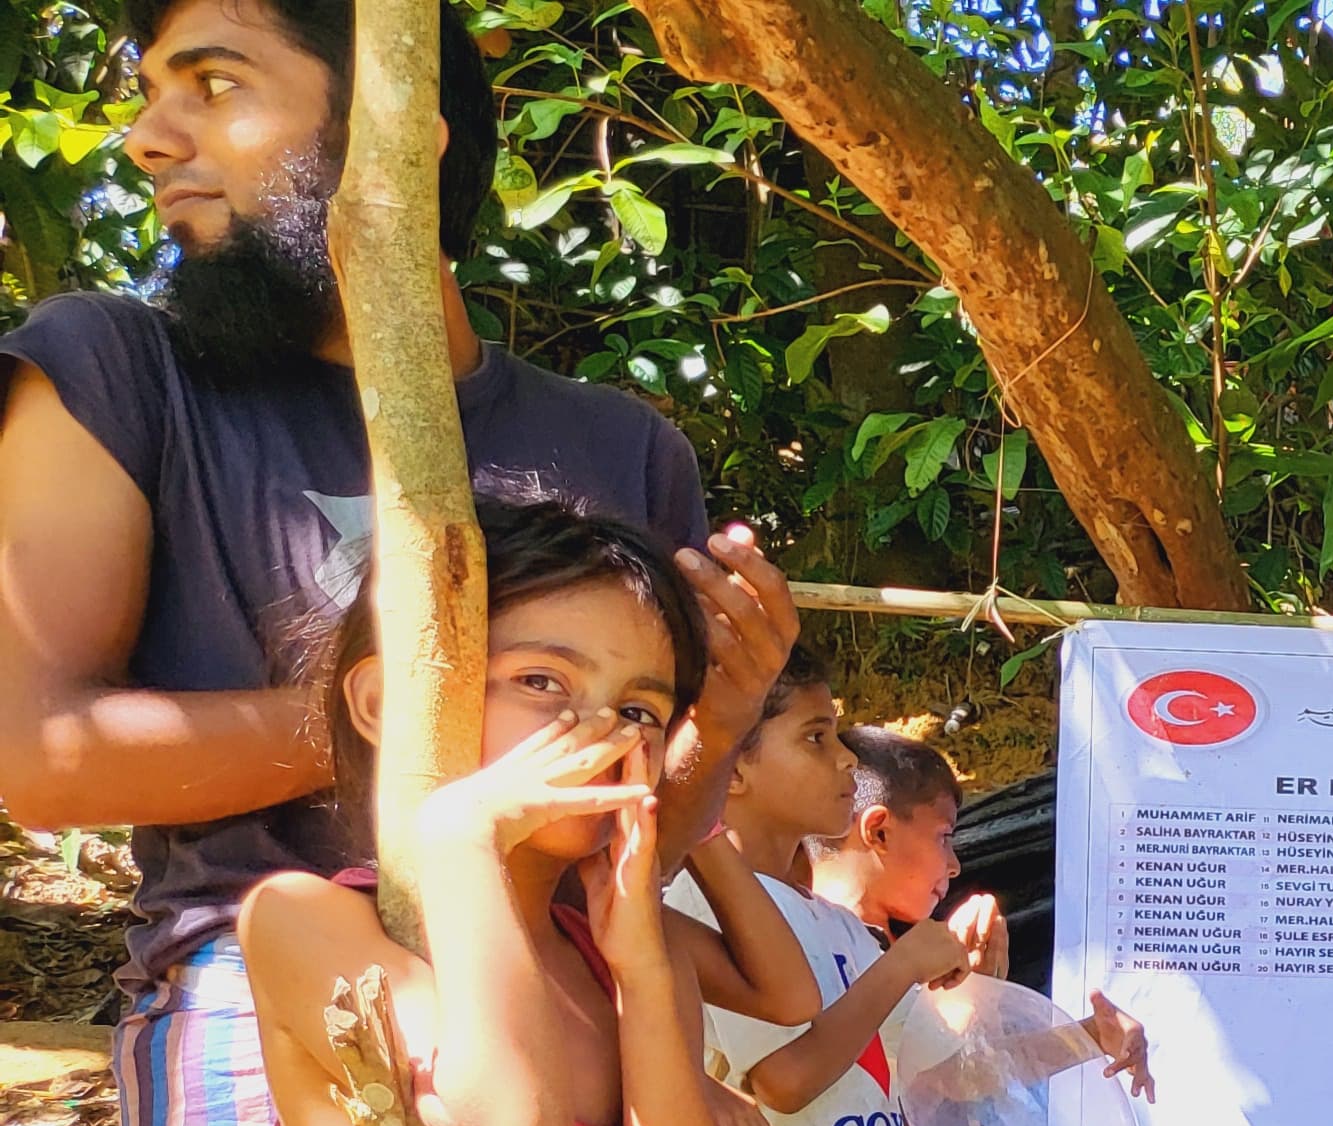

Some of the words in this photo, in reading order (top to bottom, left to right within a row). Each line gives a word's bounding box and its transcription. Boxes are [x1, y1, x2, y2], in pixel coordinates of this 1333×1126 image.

[1276, 776, 1318, 796] ER
[1137, 810, 1222, 821] MUHAMMET
[1226, 812, 1256, 823] ARİF
[1136, 826, 1181, 838] SALİHA
[1184, 829, 1255, 840] BAYRAKTAR
[1136, 844, 1189, 854] MER.NURİ
[1192, 846, 1255, 856] BAYRAKTAR
[1136, 862, 1183, 871] KENAN
[1187, 863, 1226, 873] UĞUR
[1136, 878, 1182, 887] KENAN
[1187, 878, 1226, 889] UĞUR
[1276, 881, 1316, 891] SEVGİ
[1135, 894, 1182, 905] KENAN
[1187, 895, 1225, 905] UĞUR
[1276, 898, 1322, 907] NURAY
[1135, 910, 1182, 920] KENAN
[1186, 910, 1225, 921] UĞUR
[1134, 926, 1198, 937] NERİMAN
[1203, 928, 1241, 938] UĞUR
[1275, 931, 1308, 941] ŞULE
[1133, 942, 1198, 953] NERİMAN
[1202, 944, 1241, 954] UĞUR
[1275, 947, 1315, 957] HAYIR
[1133, 960, 1197, 970] NERİMAN
[1202, 961, 1241, 972] UĞUR
[1275, 963, 1315, 973] HAYIR
